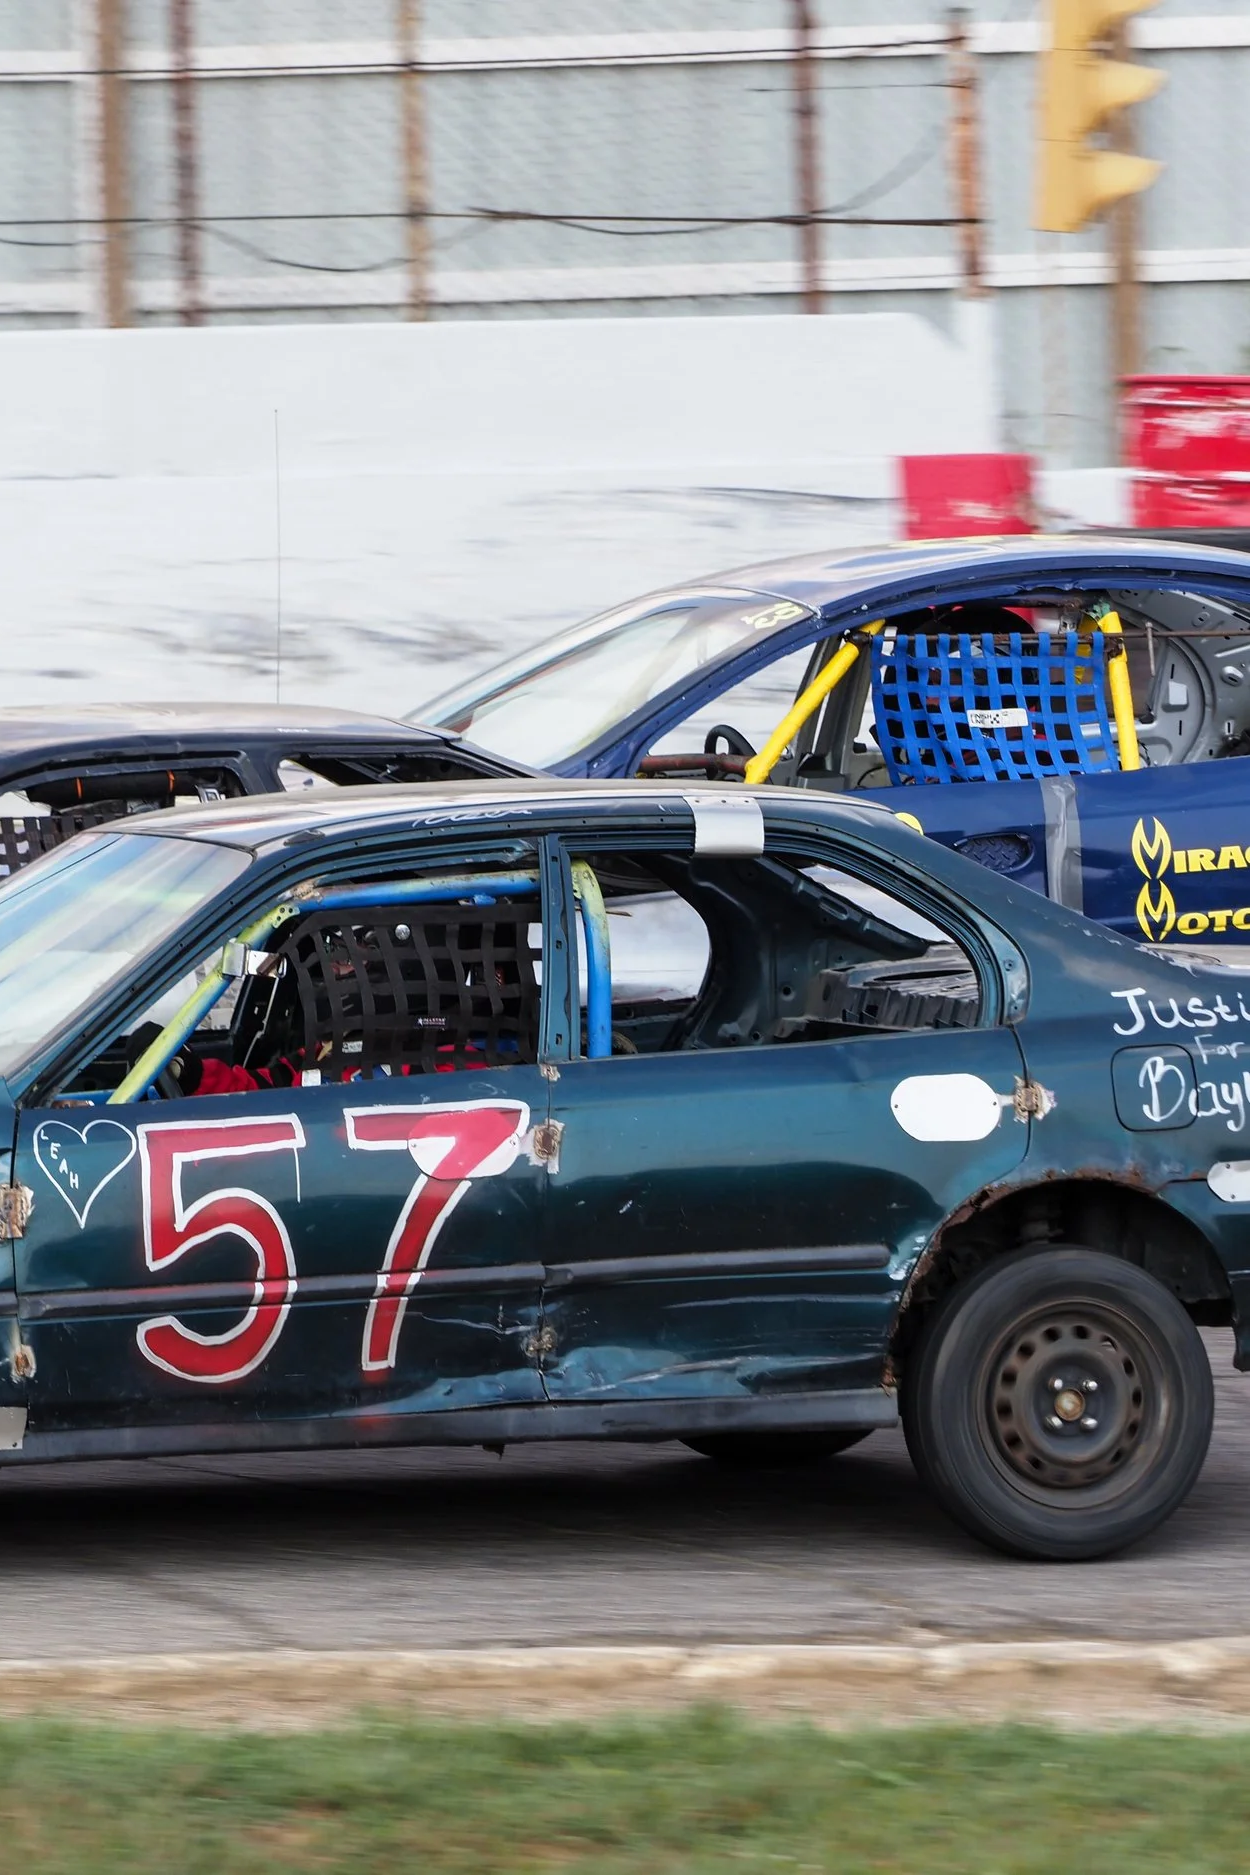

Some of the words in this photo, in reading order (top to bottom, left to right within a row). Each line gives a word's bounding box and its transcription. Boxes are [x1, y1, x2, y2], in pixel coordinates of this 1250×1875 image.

[1131, 815, 1250, 881] MIRA
[1193, 1033, 1245, 1065] For
[40, 1128, 80, 1190] LEAH
[136, 1098, 531, 1384] 57
